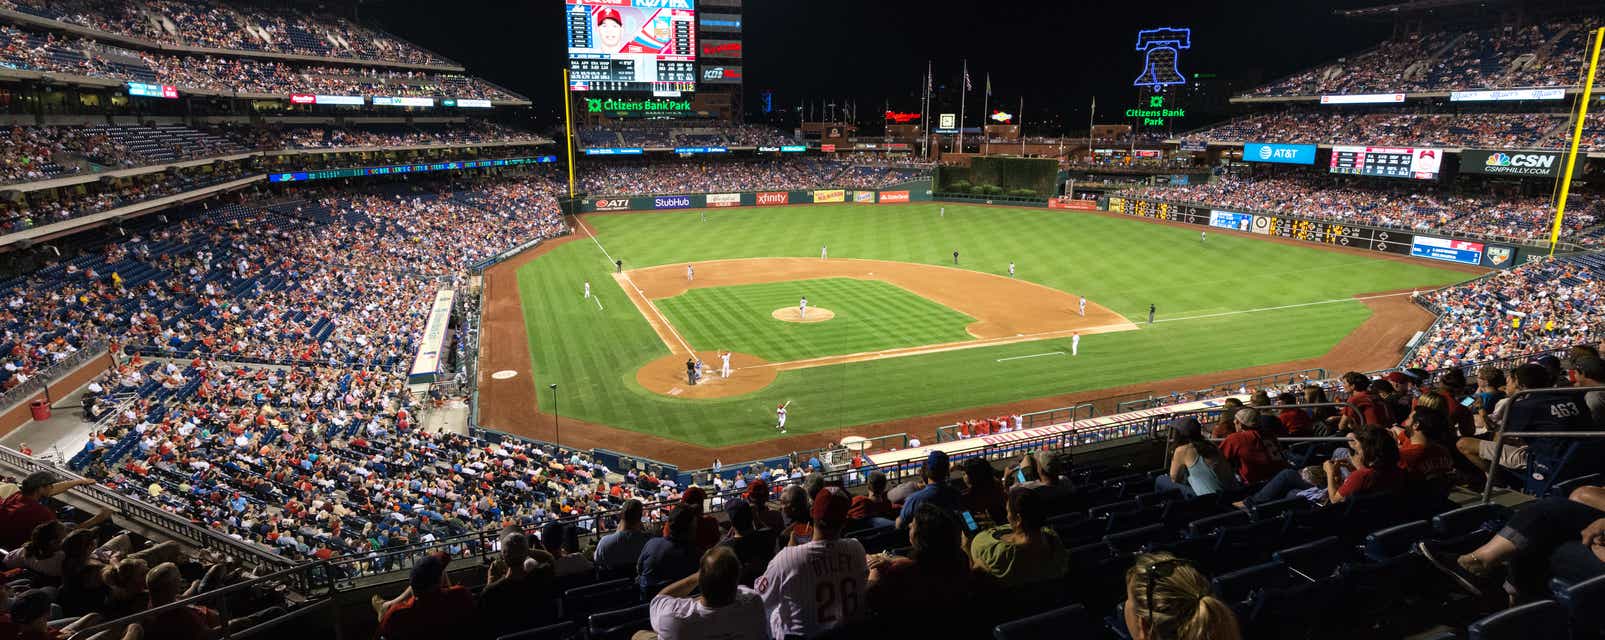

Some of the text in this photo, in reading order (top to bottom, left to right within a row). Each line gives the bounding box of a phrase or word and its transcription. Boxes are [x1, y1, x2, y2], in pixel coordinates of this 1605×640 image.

[603, 100, 691, 111] Citizens Bank Park
[1126, 108, 1185, 117] Citizens Bank
[1144, 117, 1164, 126] Park
[1273, 149, 1299, 159] AT&T
[1510, 154, 1555, 168] CSN
[1484, 166, 1550, 175] CSNPHILLY.COM
[607, 199, 629, 207] ATI
[655, 198, 690, 207] StubHub
[758, 193, 786, 204] xfinity
[1550, 401, 1580, 419] 463
[815, 576, 858, 624] 26
